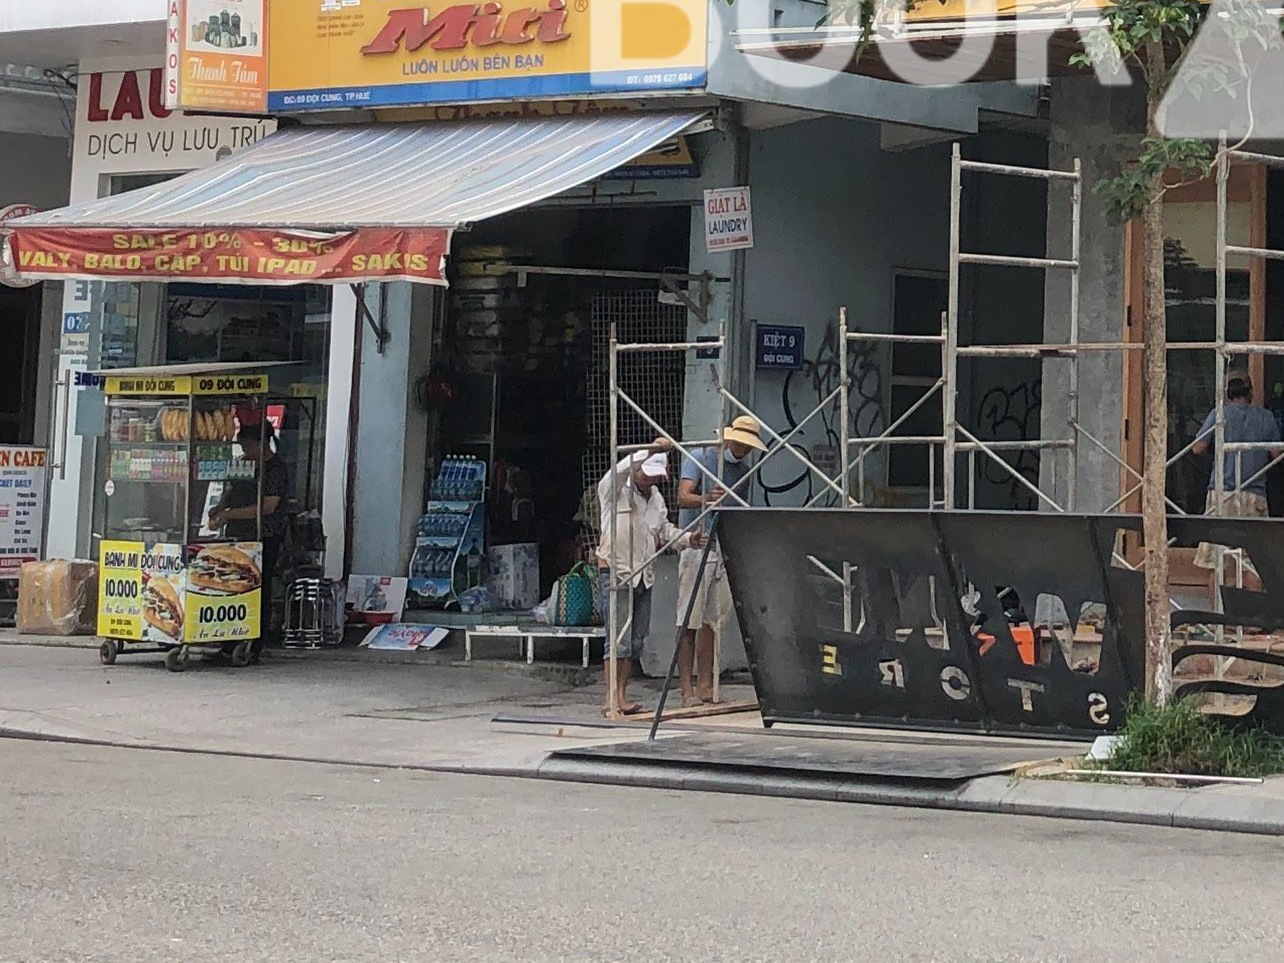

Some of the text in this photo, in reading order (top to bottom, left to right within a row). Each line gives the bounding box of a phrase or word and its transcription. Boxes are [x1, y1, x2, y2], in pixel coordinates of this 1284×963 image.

[402, 57, 438, 76] LUÔN
[88, 133, 137, 159] DỊCH
[147, 131, 174, 158] VỤ
[183, 127, 220, 151] LƯU
[709, 217, 748, 234] LAUNDRY
[112, 233, 178, 250] SALE
[256, 256, 318, 275] IPAD
[789, 334, 796, 348] 9
[200, 378, 213, 391] 09
[237, 376, 262, 390] CUNG
[14, 450, 45, 468] CAFE
[105, 578, 138, 599] 10.000
[199, 604, 247, 624] 10.000
